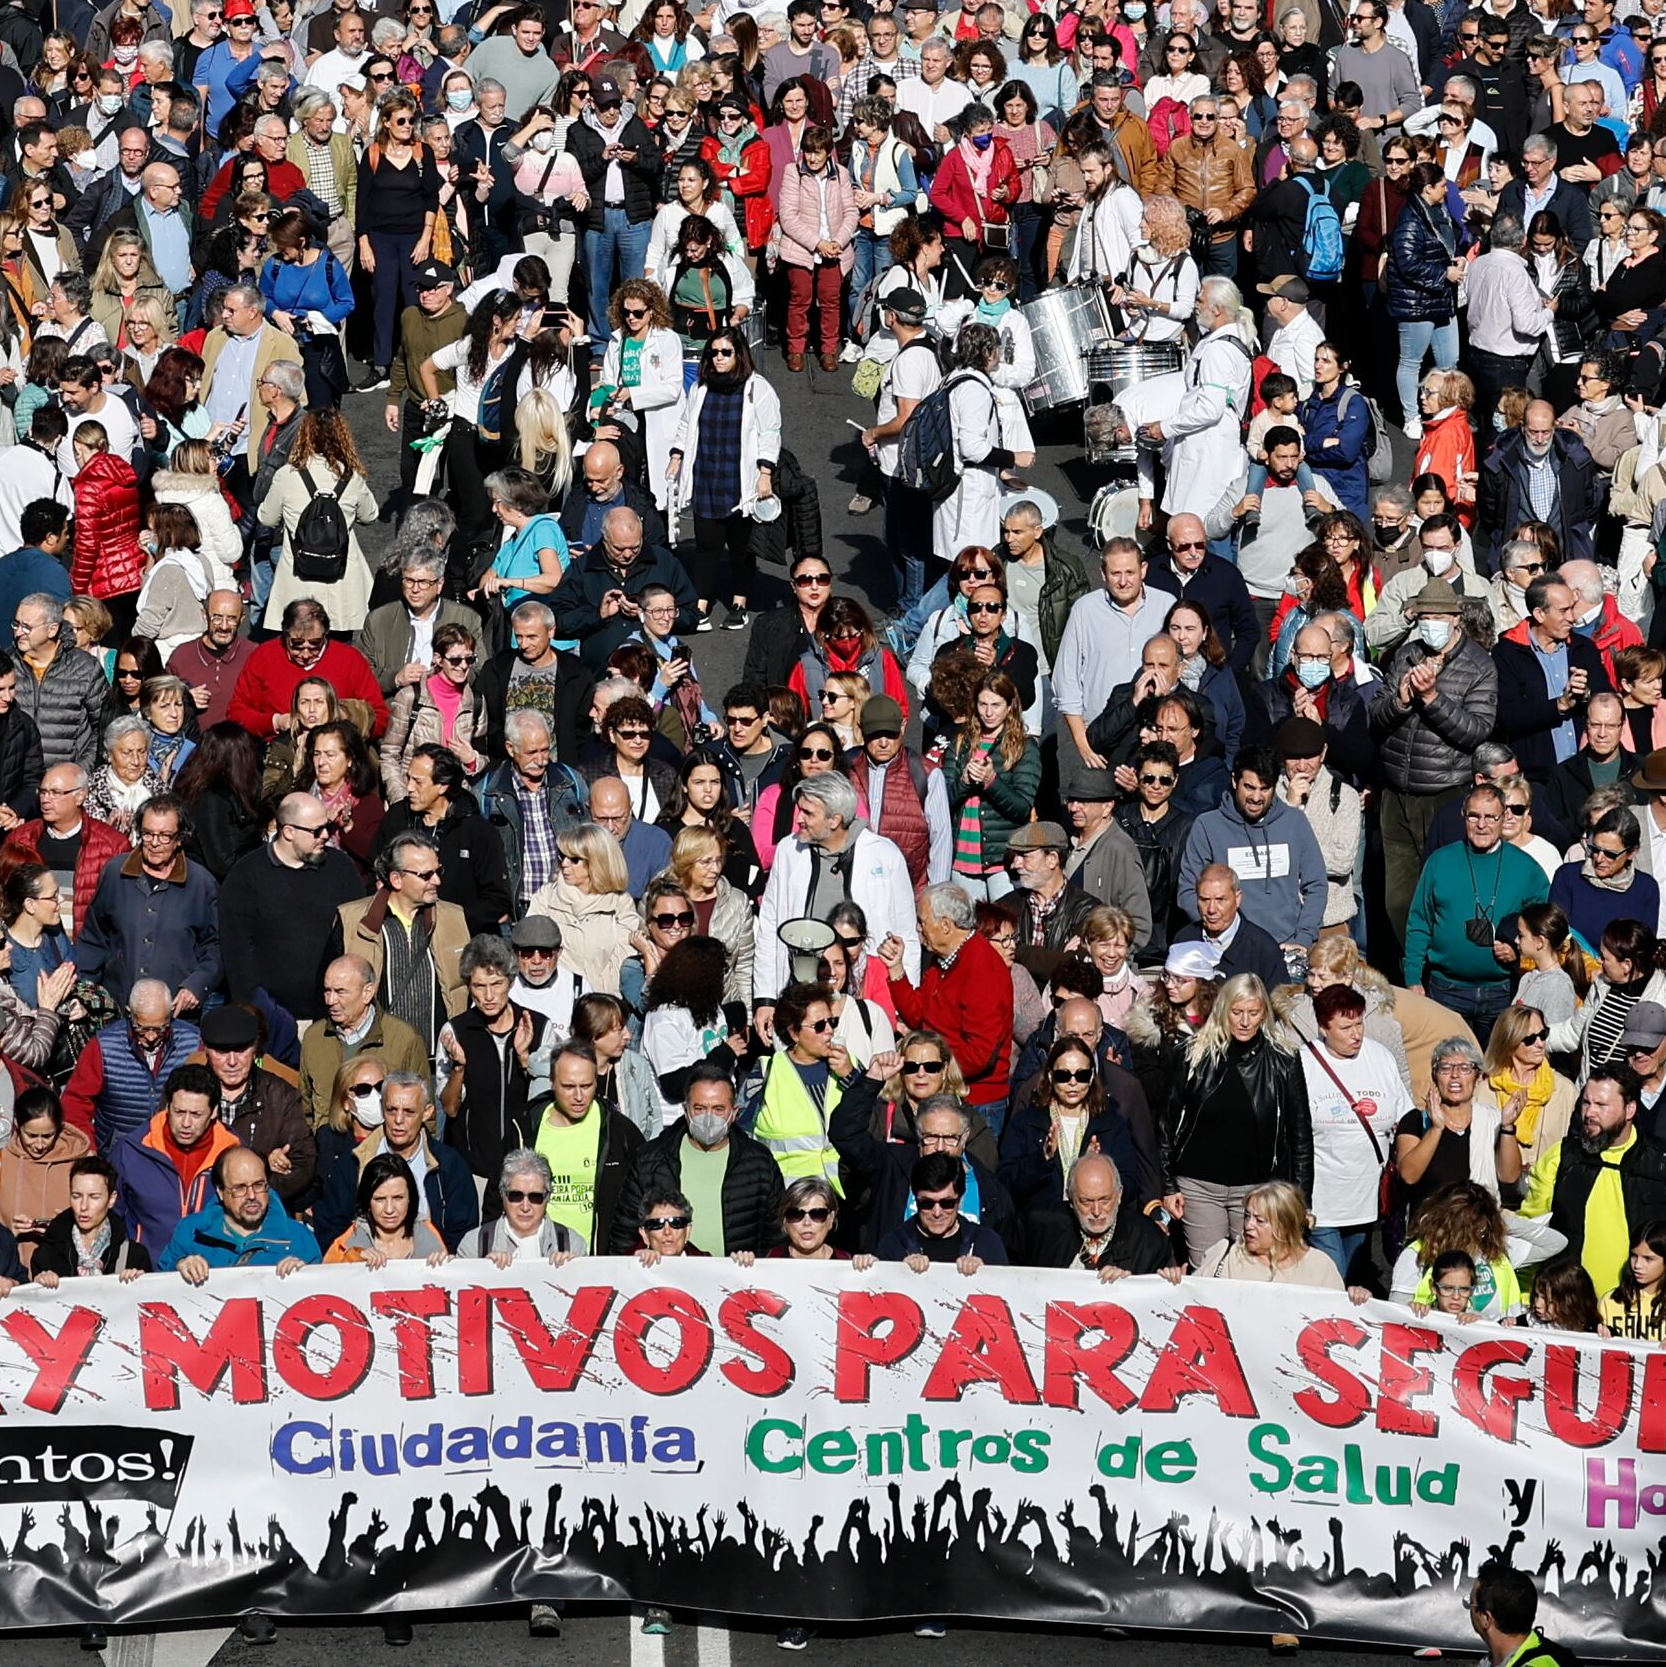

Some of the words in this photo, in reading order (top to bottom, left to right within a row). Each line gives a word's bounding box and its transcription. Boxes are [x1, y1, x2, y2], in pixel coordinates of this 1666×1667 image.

[134, 1286, 797, 1412] MOTIVOS
[836, 1290, 1257, 1424] PARA
[272, 1414, 699, 1476] Ciudadanía
[745, 1412, 1050, 1477] Centros
[1096, 1419, 1197, 1486] de
[1247, 1422, 1460, 1506] Salud
[1501, 1480, 1539, 1528] y
